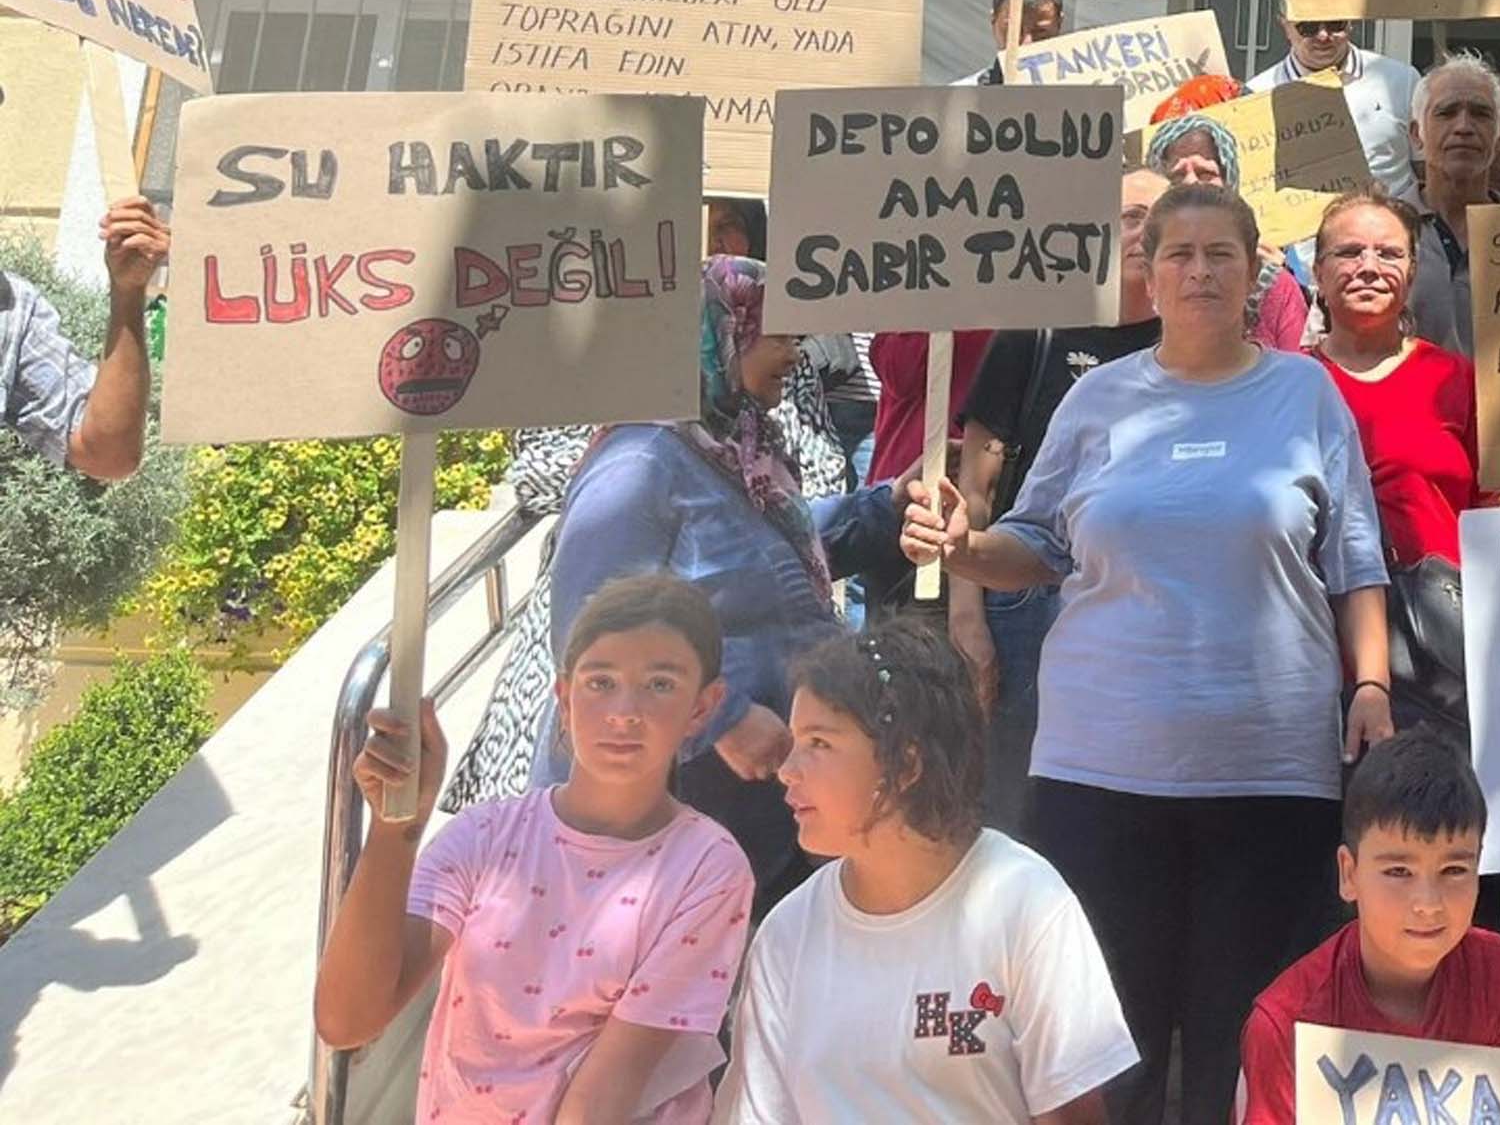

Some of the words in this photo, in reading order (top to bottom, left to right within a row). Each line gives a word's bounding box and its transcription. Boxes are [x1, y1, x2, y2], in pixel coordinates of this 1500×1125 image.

[792, 27, 854, 54] YADA
[1092, 48, 1210, 101] ÖRDÜK
[808, 112, 939, 157] DEPO
[966, 109, 1114, 159] DOLDU
[208, 144, 338, 207] SU
[388, 136, 652, 196] HAKTIR
[879, 174, 1025, 220] AMA
[204, 243, 416, 323] LÜKS
[455, 220, 677, 309] DEĞİL!
[785, 233, 950, 300] SABIR
